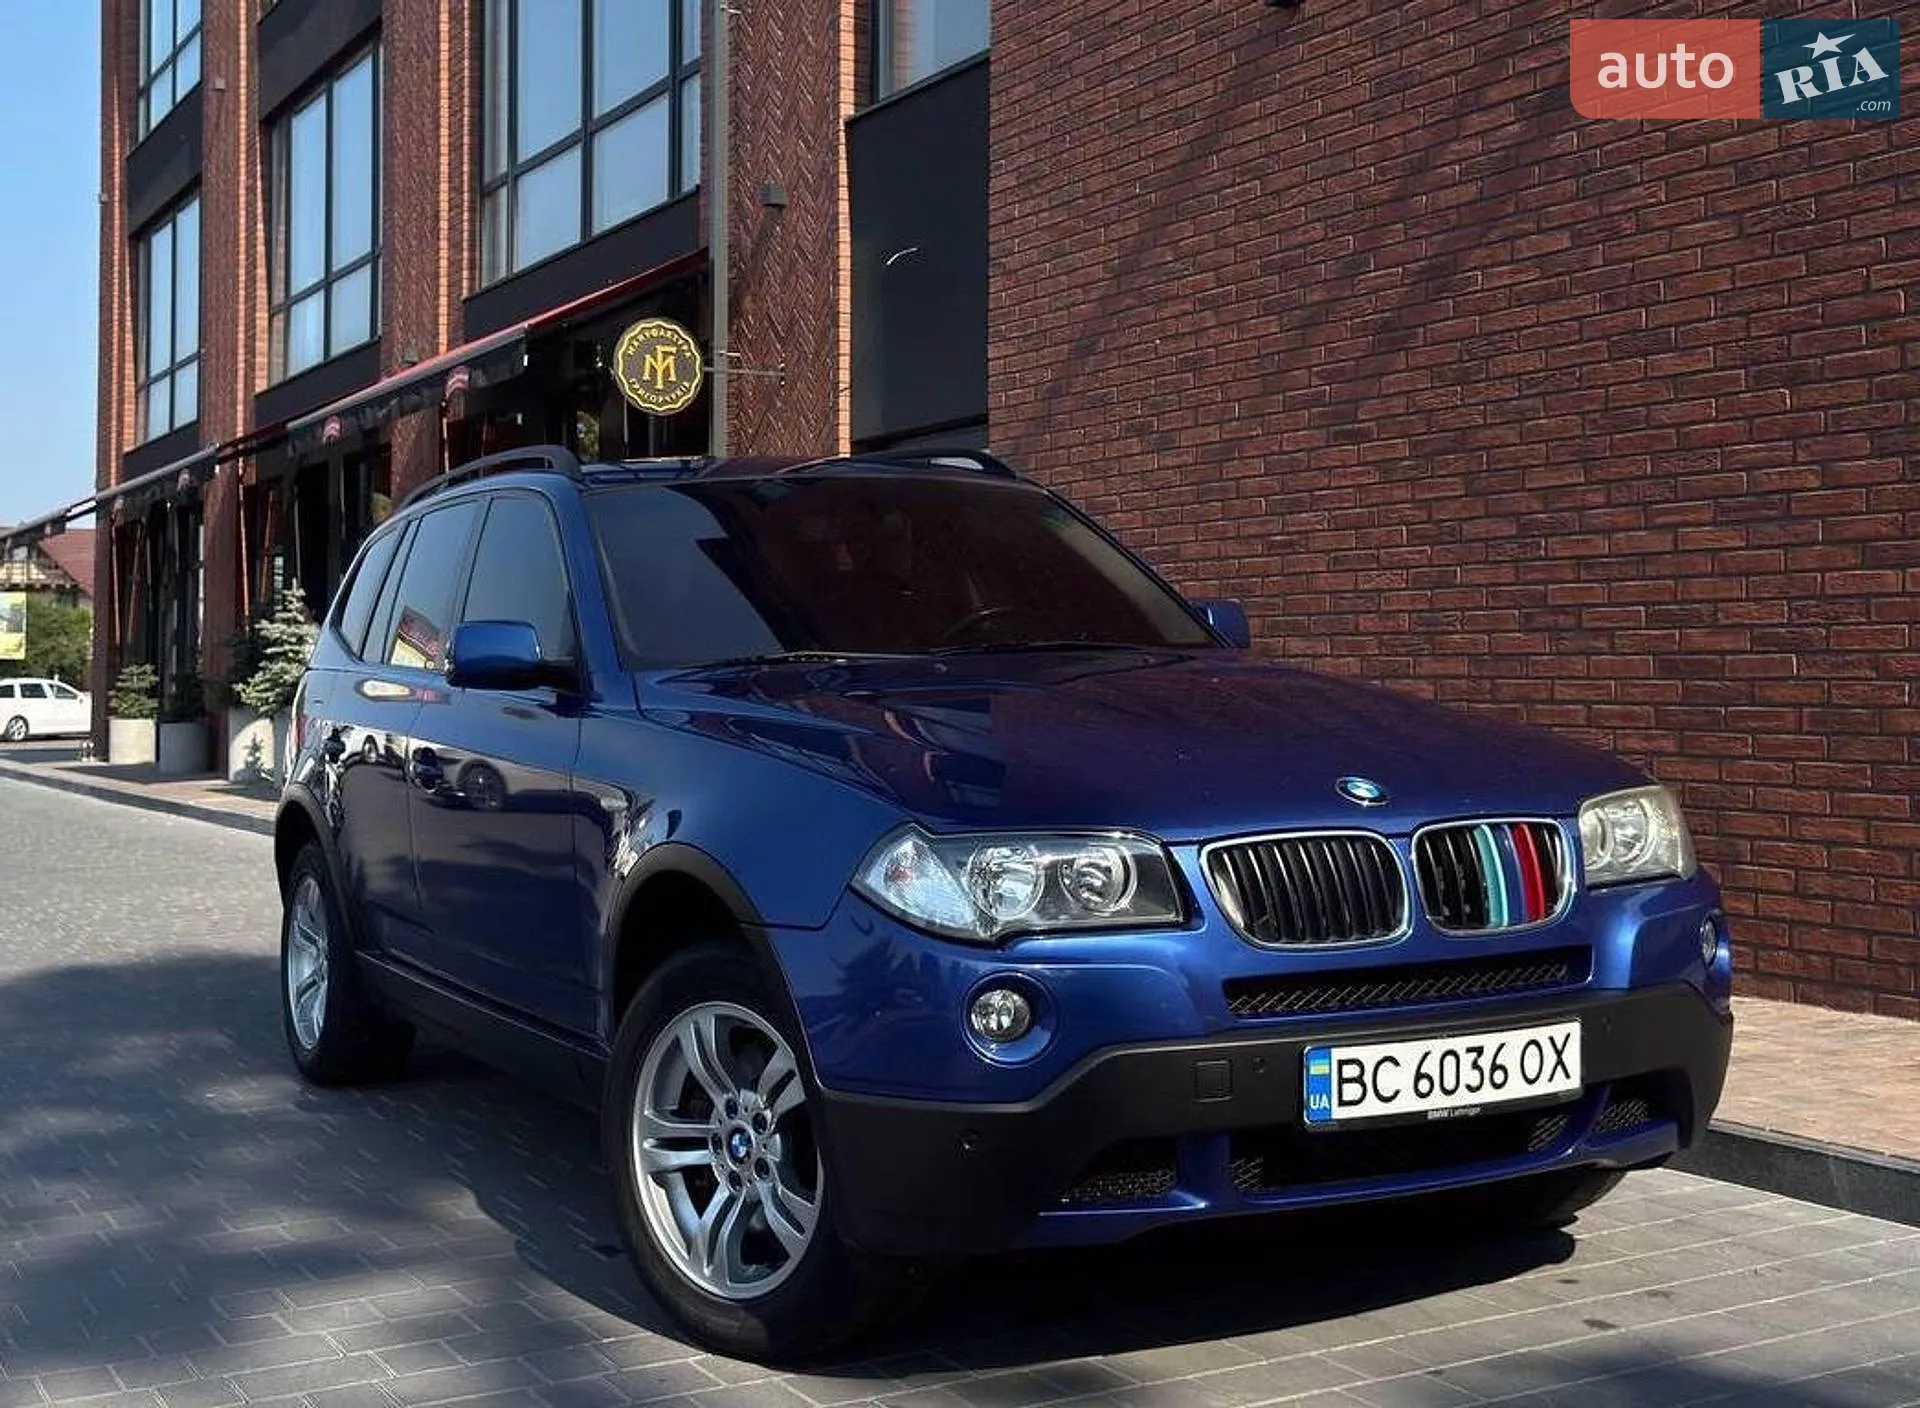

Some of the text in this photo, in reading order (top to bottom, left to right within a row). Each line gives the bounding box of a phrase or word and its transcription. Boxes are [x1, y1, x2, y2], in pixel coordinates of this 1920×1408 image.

[1337, 1032, 1571, 1107] BC 6036 OX
[1309, 1095, 1330, 1111] UA
